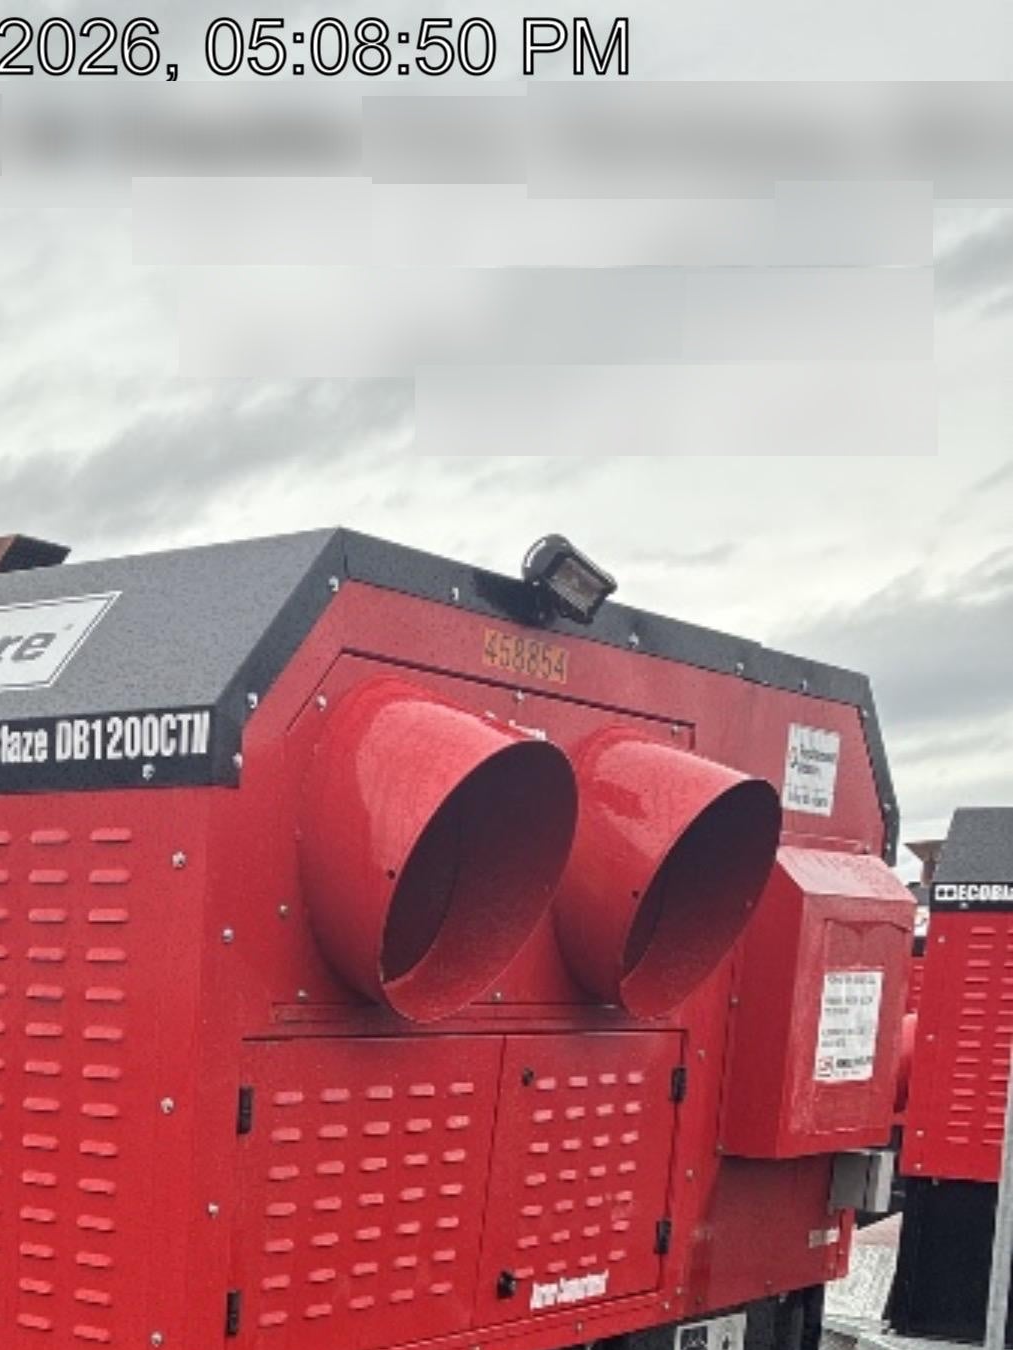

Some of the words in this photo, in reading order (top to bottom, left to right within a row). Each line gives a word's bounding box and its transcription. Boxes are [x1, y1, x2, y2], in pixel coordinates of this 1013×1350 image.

[485, 631, 566, 681] 458854
[55, 711, 210, 762] DB1200CTN
[958, 884, 1013, 901] ECOBl
